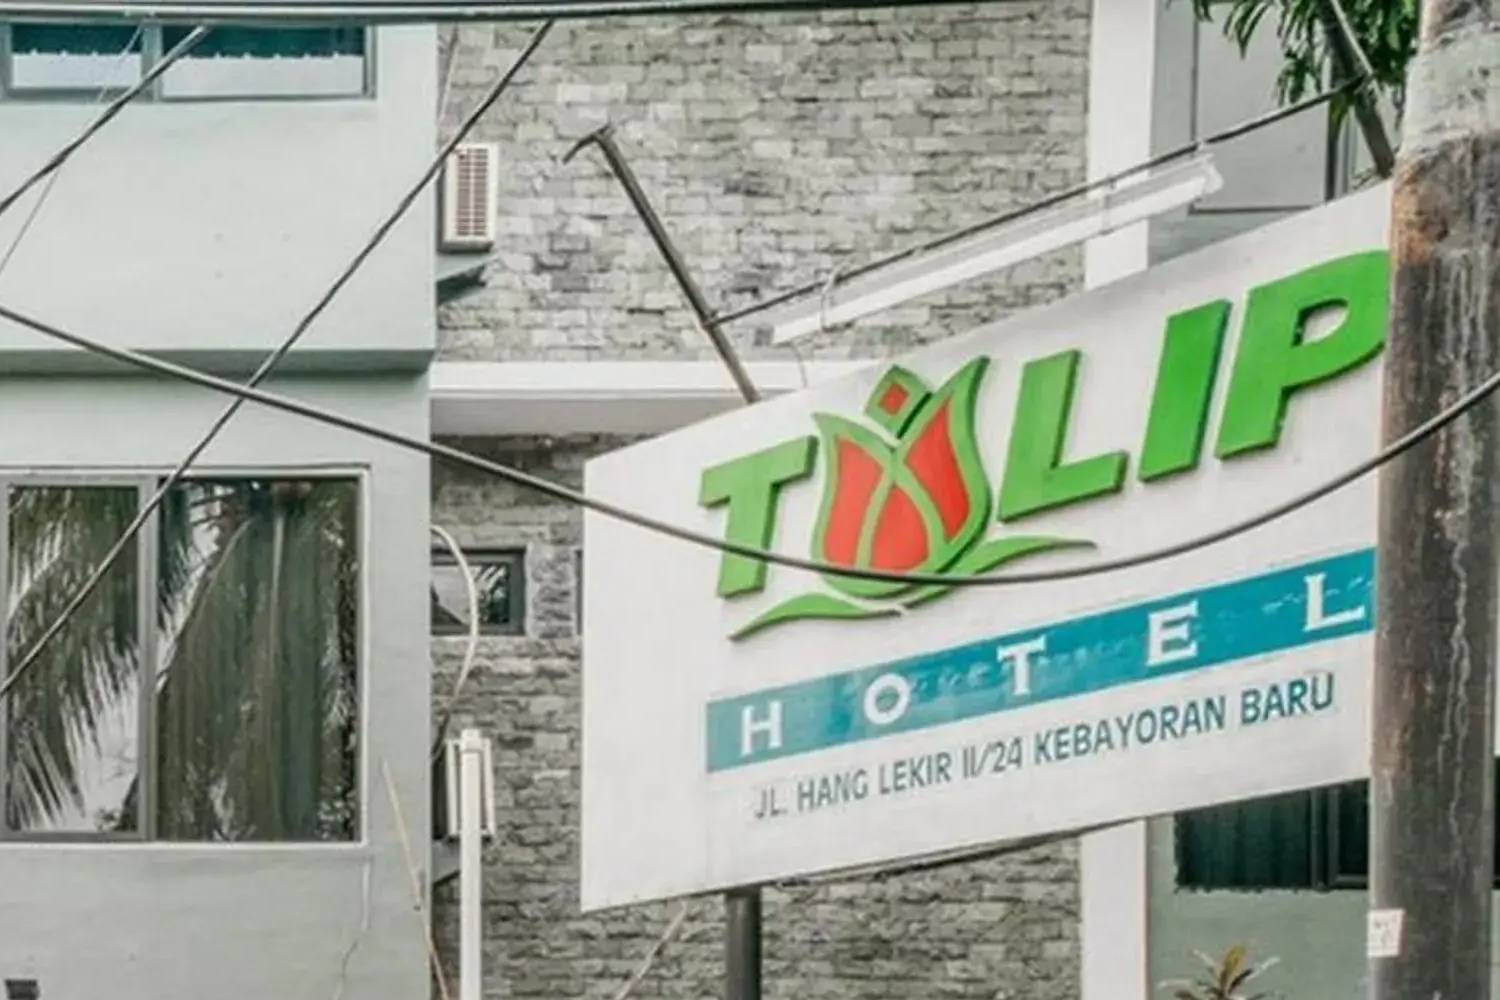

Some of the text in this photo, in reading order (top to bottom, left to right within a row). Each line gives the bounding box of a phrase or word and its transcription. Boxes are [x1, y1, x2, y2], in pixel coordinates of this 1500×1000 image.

[700, 249, 1388, 606] TULIP
[741, 573, 1366, 756] HOTEL
[755, 785, 787, 819] JL.
[797, 768, 869, 815] HANG
[879, 751, 953, 796] LEKIR
[1033, 695, 1226, 766] KEBAYORAN
[1241, 672, 1335, 726] BARU
